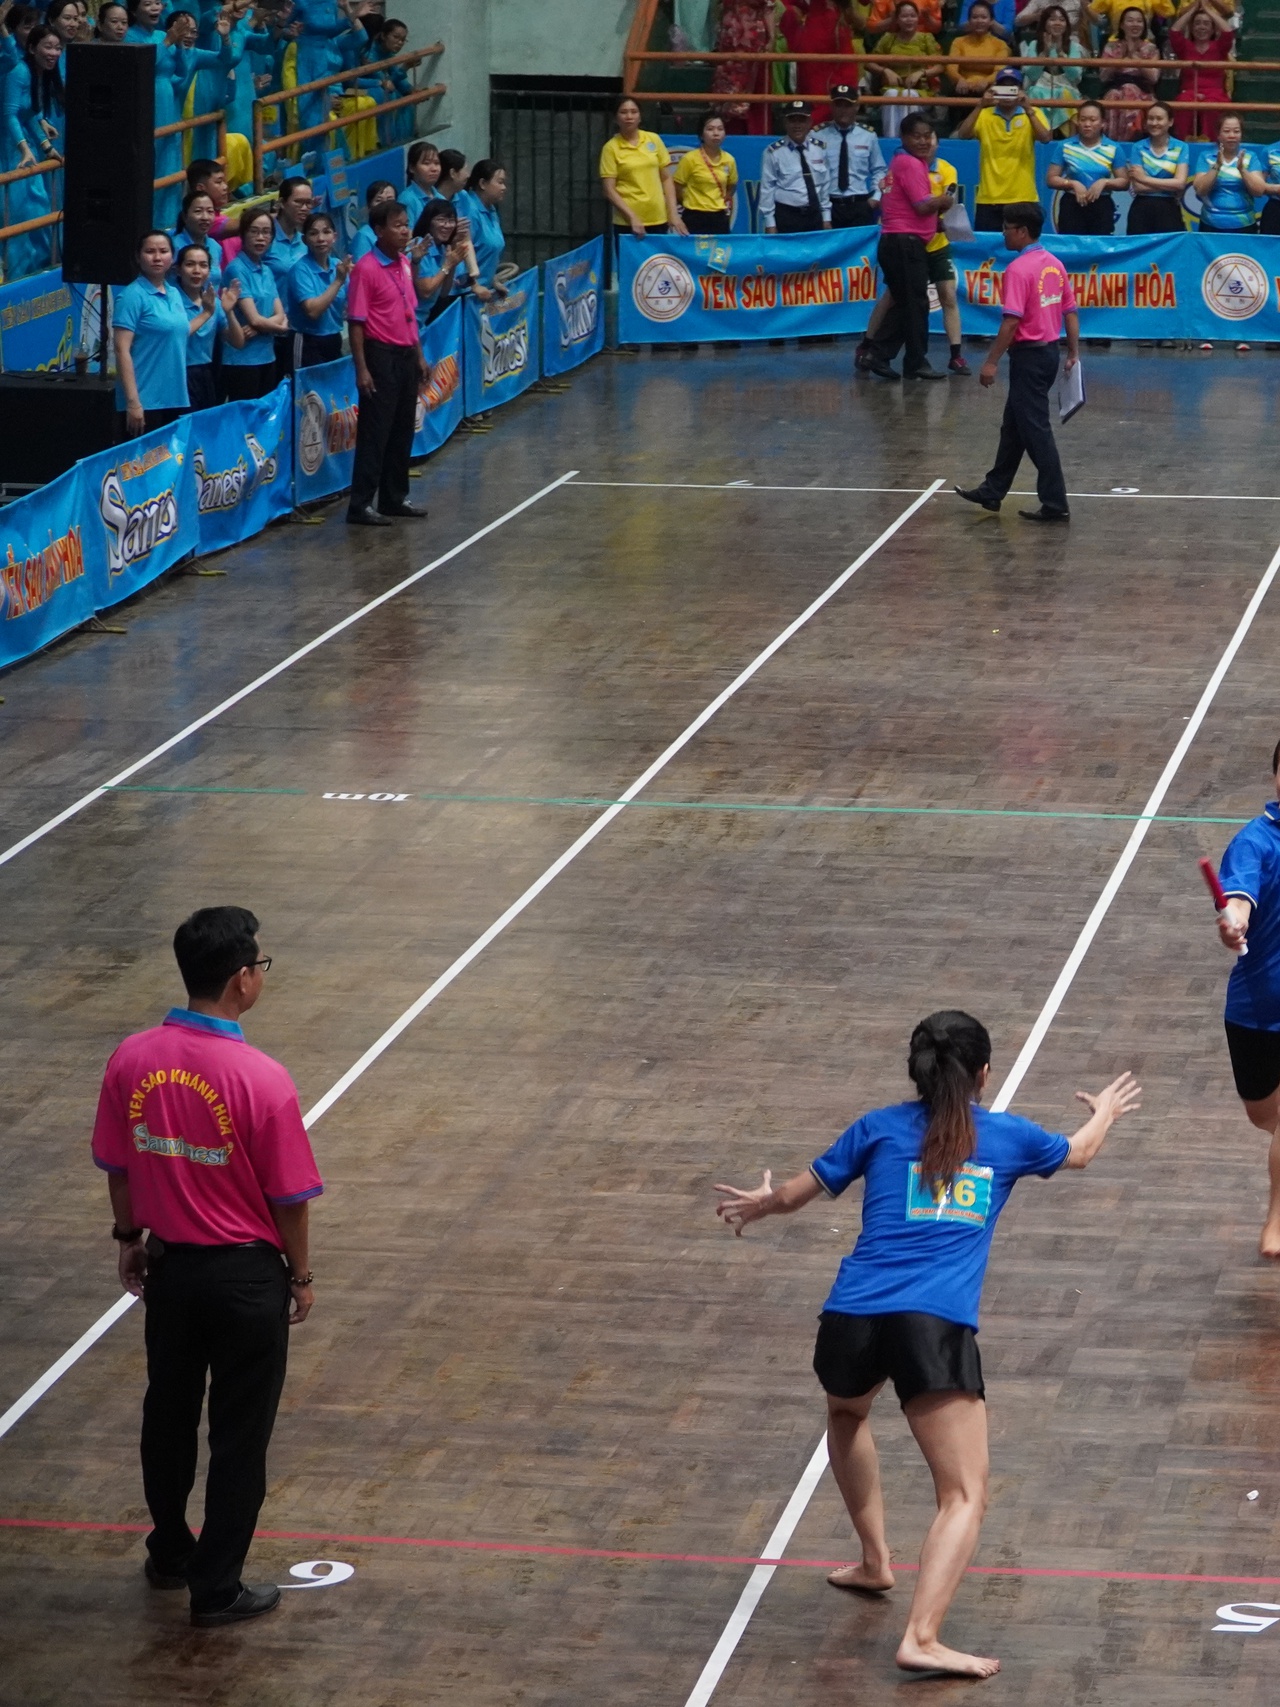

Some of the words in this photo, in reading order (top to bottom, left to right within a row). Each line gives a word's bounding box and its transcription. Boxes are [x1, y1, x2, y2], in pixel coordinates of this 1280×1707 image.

[741, 264, 777, 309] SÀO
[781, 262, 843, 307] KHÁNH
[1132, 263, 1177, 308] HÒA
[141, 1070, 167, 1093] SÀO
[170, 1068, 219, 1105] KHÁNH
